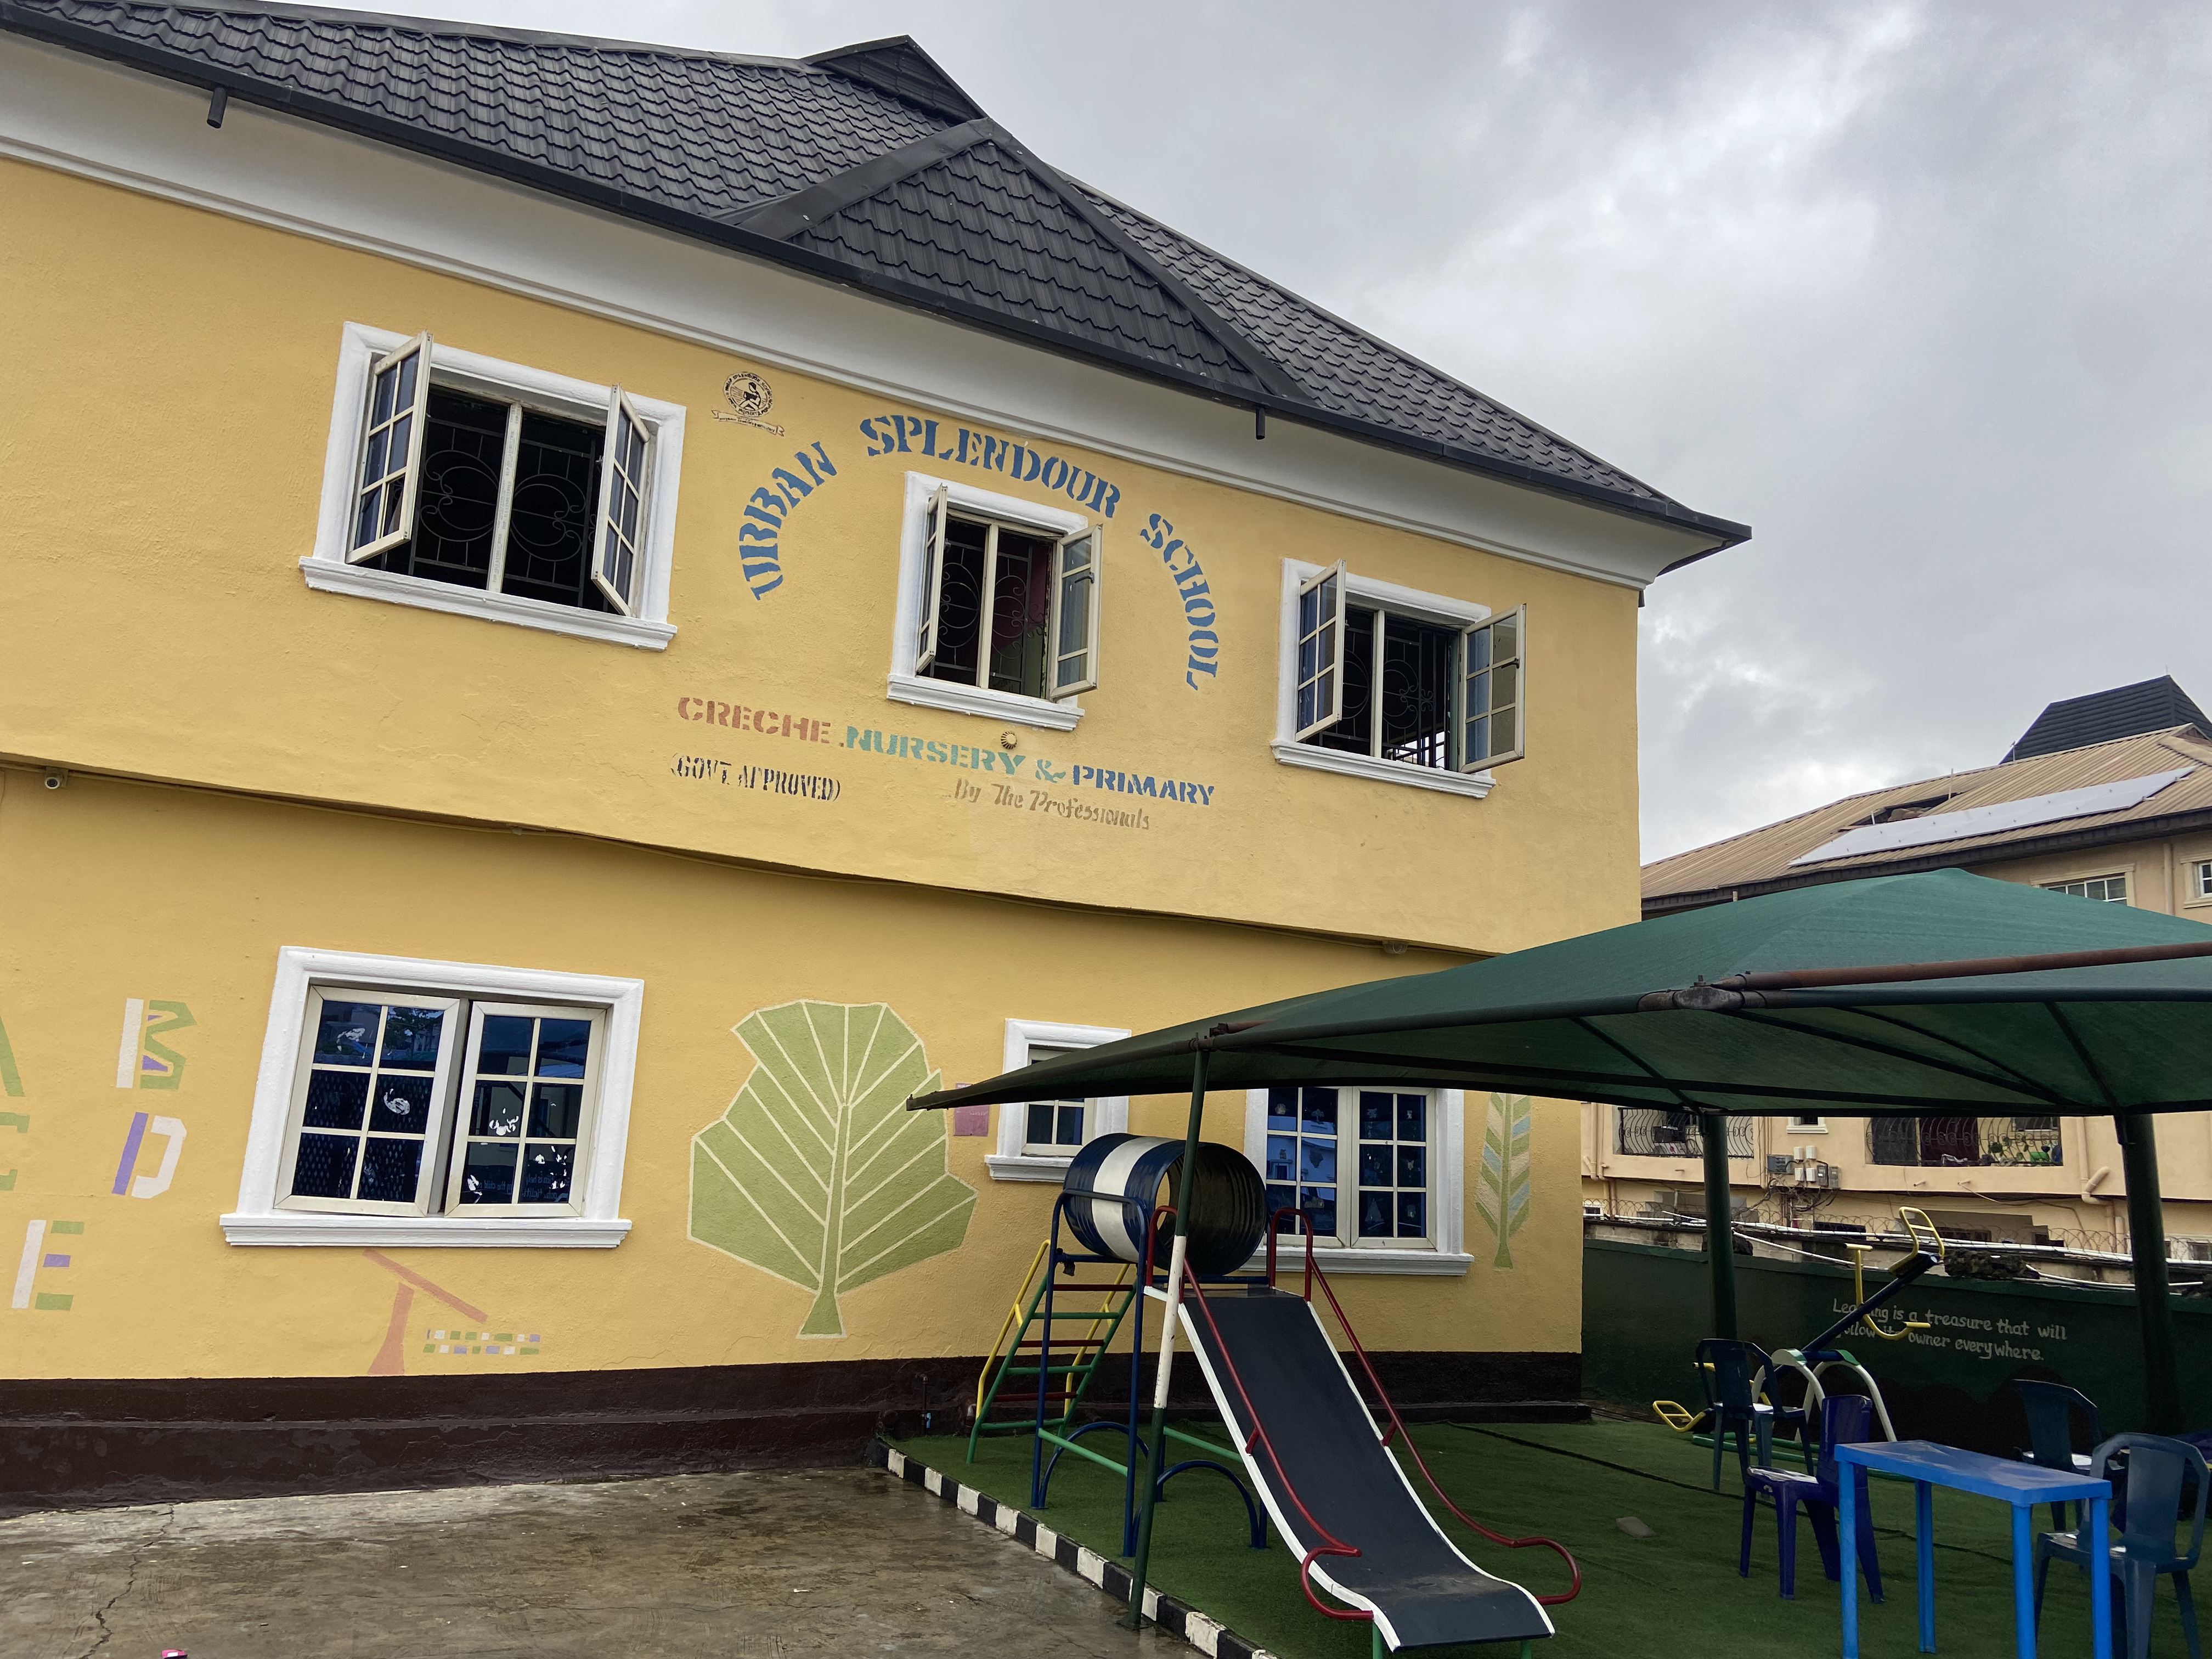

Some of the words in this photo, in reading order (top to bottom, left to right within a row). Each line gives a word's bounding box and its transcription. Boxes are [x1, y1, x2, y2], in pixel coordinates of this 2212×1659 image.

[739, 441, 838, 601] URBAN
[860, 415, 1120, 518] SPLENDOUR
[1140, 514, 1218, 691] SCHOOL
[1035, 759, 1066, 783] &
[1073, 765, 1215, 805] PRIMARY
[991, 783, 1024, 809] The
[1029, 790, 1149, 830] Professionals
[1833, 1297, 1889, 1323] Leaing
[1893, 1305, 1904, 1320] is
[1909, 1312, 1918, 1322] a
[1925, 1309, 1993, 1331] treasure
[1996, 1318, 2030, 1335] that
[2037, 1324, 2067, 1340] will
[1835, 1321, 1876, 1338] llow
[1908, 1331, 1950, 1347] owner
